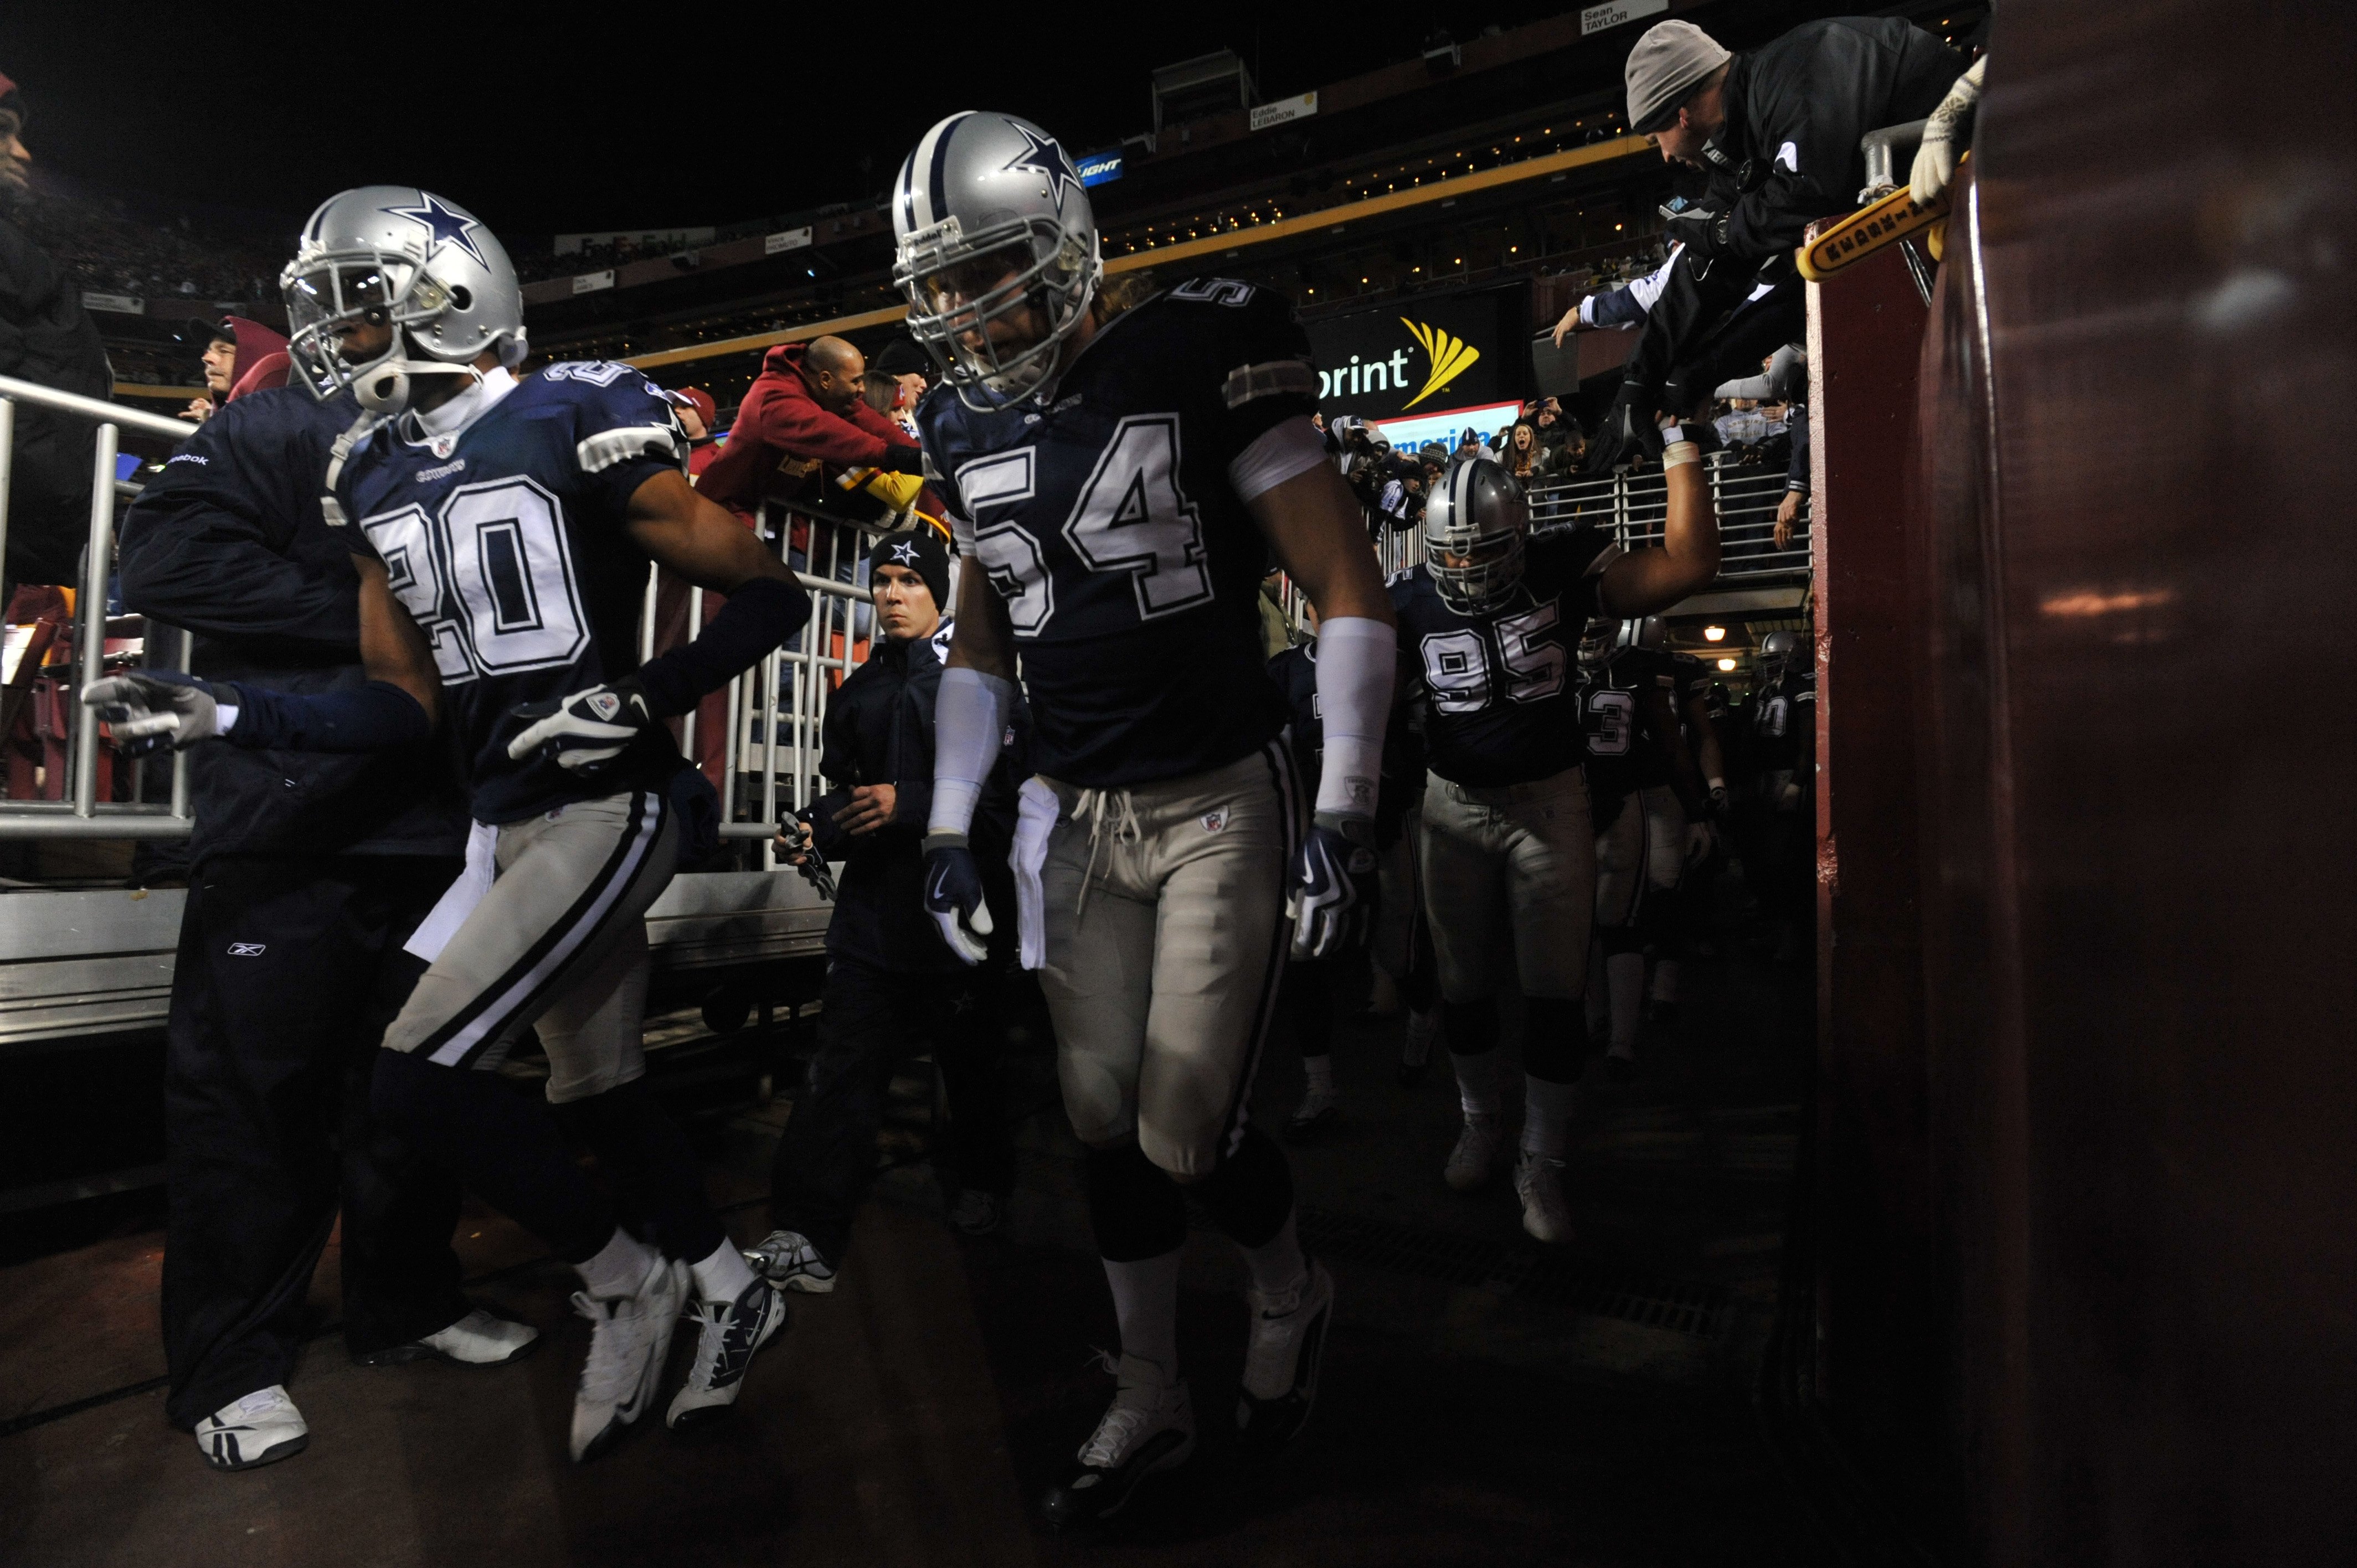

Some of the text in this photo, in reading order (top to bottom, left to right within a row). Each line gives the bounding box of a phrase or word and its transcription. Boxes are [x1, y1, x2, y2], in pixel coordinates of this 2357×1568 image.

[1584, 7, 1613, 21] Sean
[1585, 11, 1627, 31] TAYLOR
[1253, 107, 1277, 118] Eddie
[1253, 109, 1295, 127] LEBARON
[955, 411, 1215, 638] 54
[359, 474, 591, 687] 20
[1419, 598, 1567, 716] 95
[1575, 690, 1635, 756] 3
